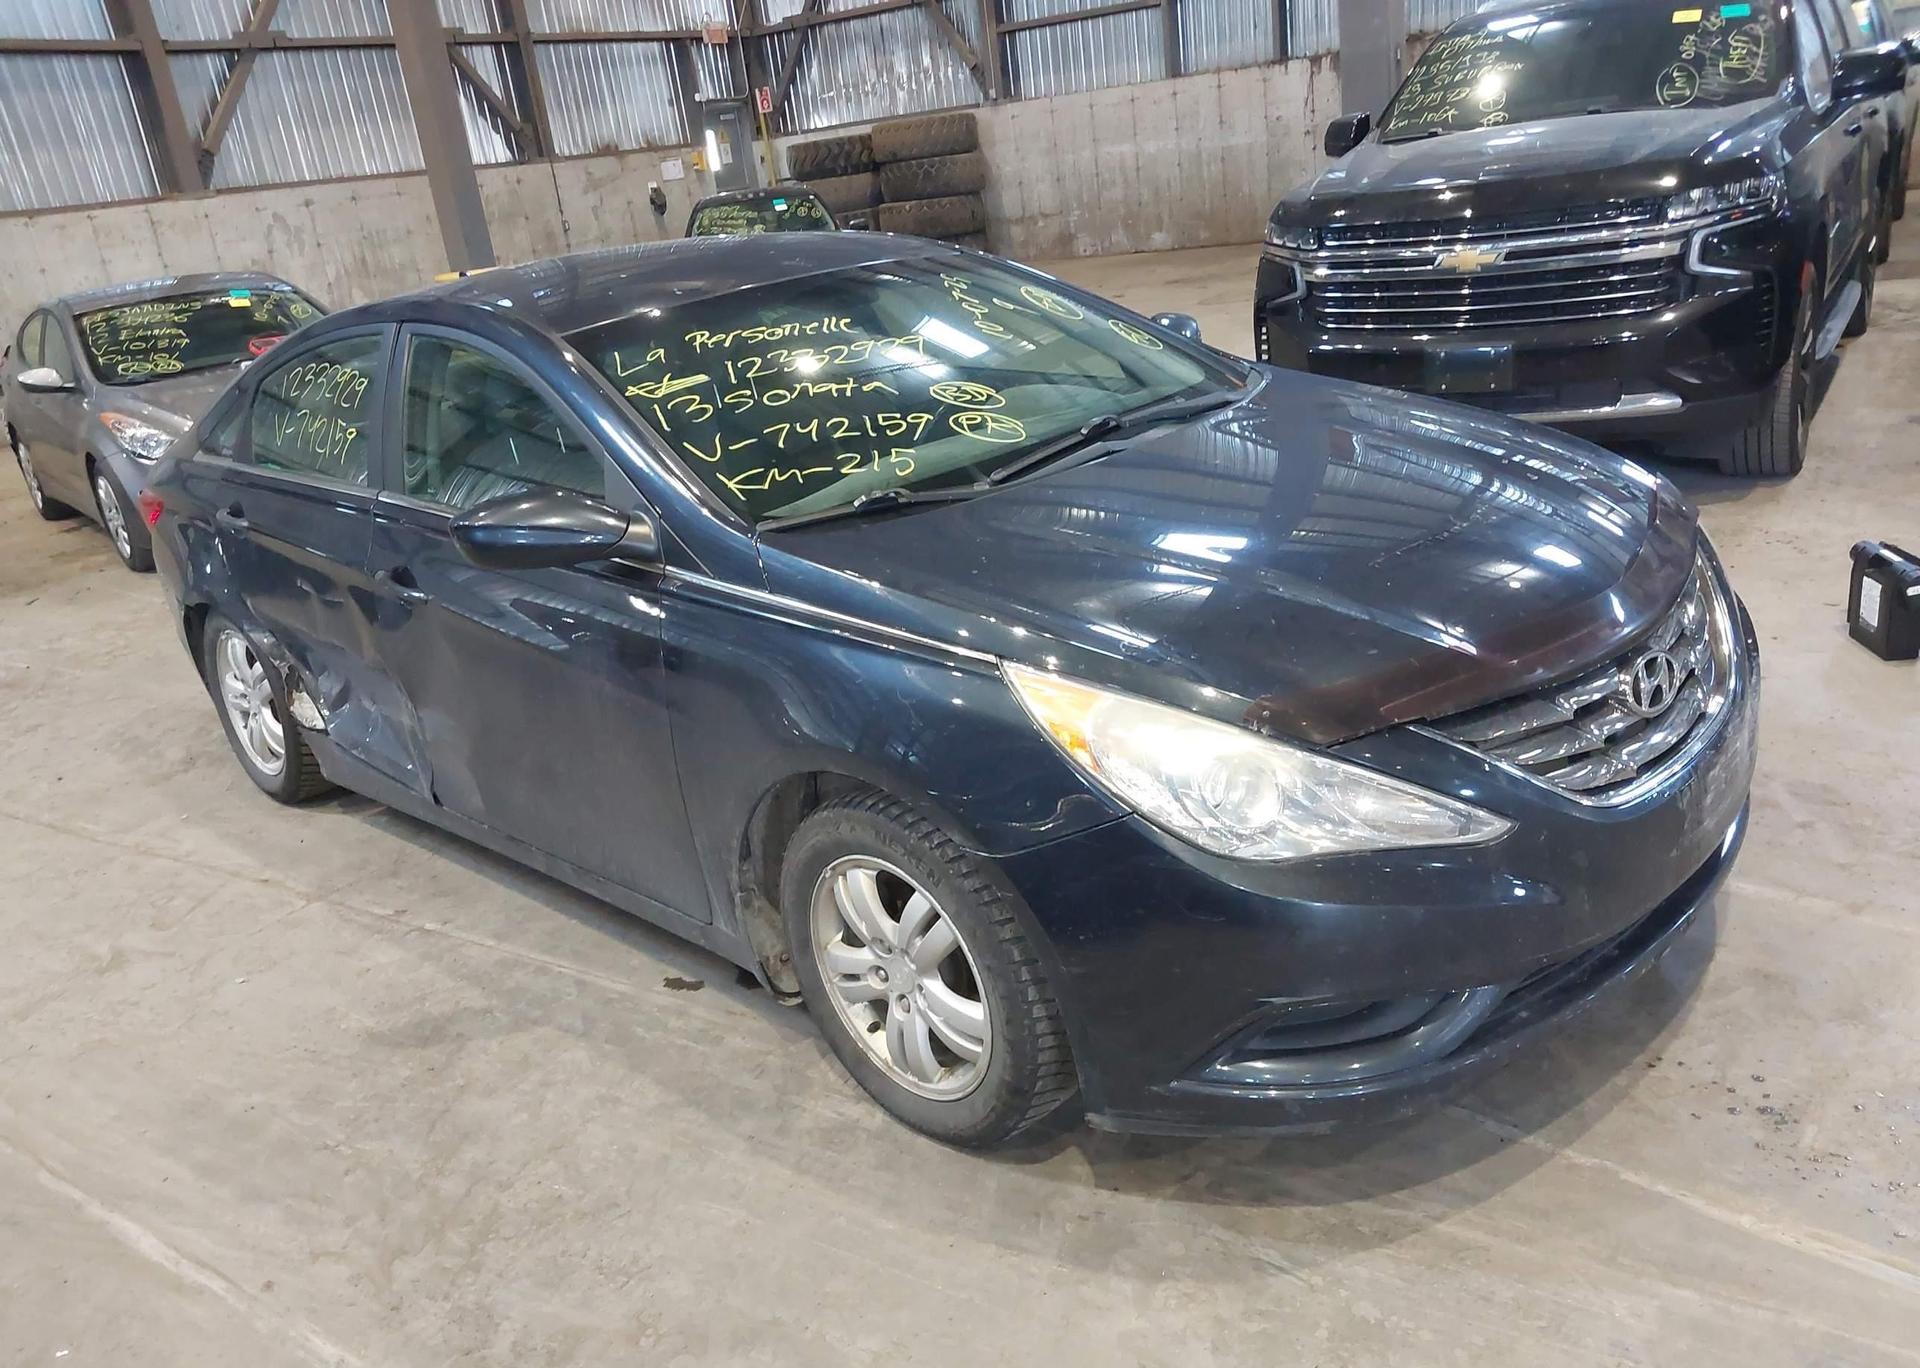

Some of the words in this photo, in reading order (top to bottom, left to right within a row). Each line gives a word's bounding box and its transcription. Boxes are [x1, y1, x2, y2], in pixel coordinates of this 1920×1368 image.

[281, 362, 369, 410] 12332929
[614, 349, 666, 378] La
[275, 408, 357, 466] V-742159
[650, 393, 714, 433] 13
[682, 412, 935, 463] V-742159
[715, 447, 917, 501] KM-215
